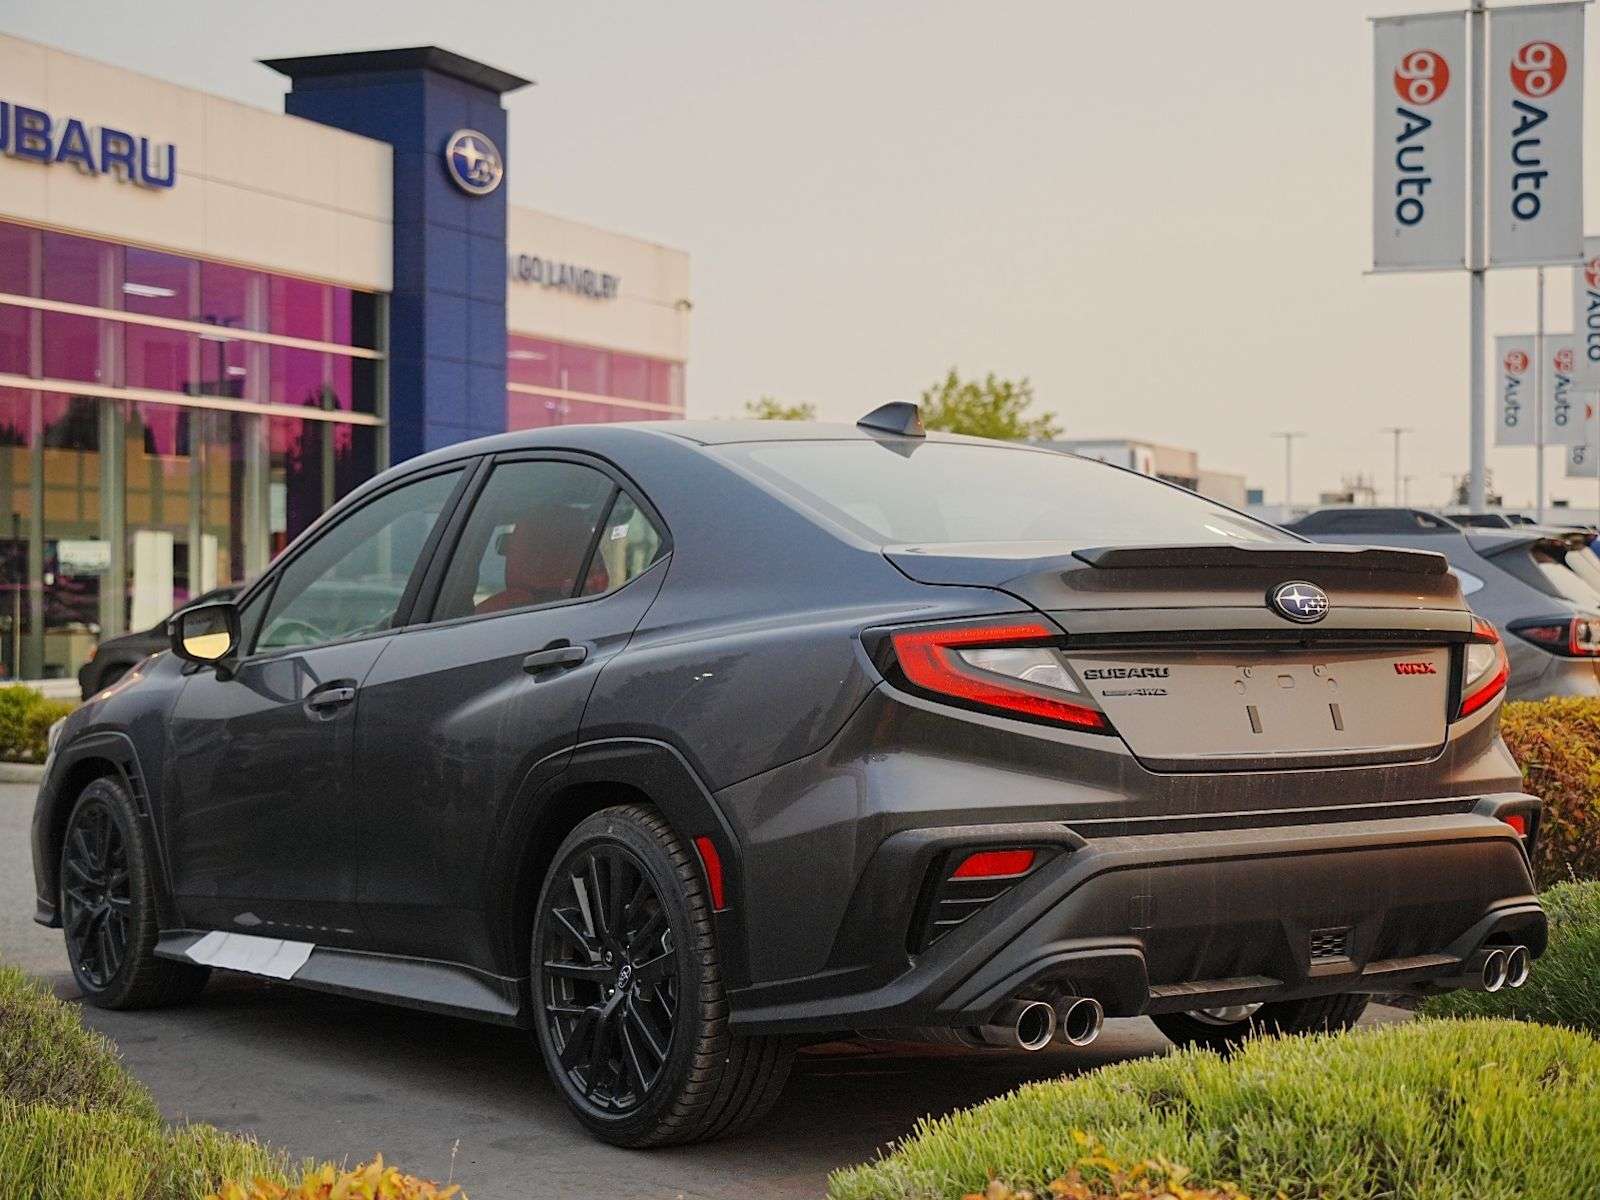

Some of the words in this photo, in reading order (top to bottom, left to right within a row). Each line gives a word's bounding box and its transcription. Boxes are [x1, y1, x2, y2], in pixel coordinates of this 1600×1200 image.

[1395, 106, 1432, 227] Auto
[1511, 99, 1549, 221] Auto
[1504, 375, 1521, 427] Auto
[1554, 374, 1570, 427] Auto
[1083, 666, 1170, 680] SUBARU
[1393, 662, 1437, 675] WRX
